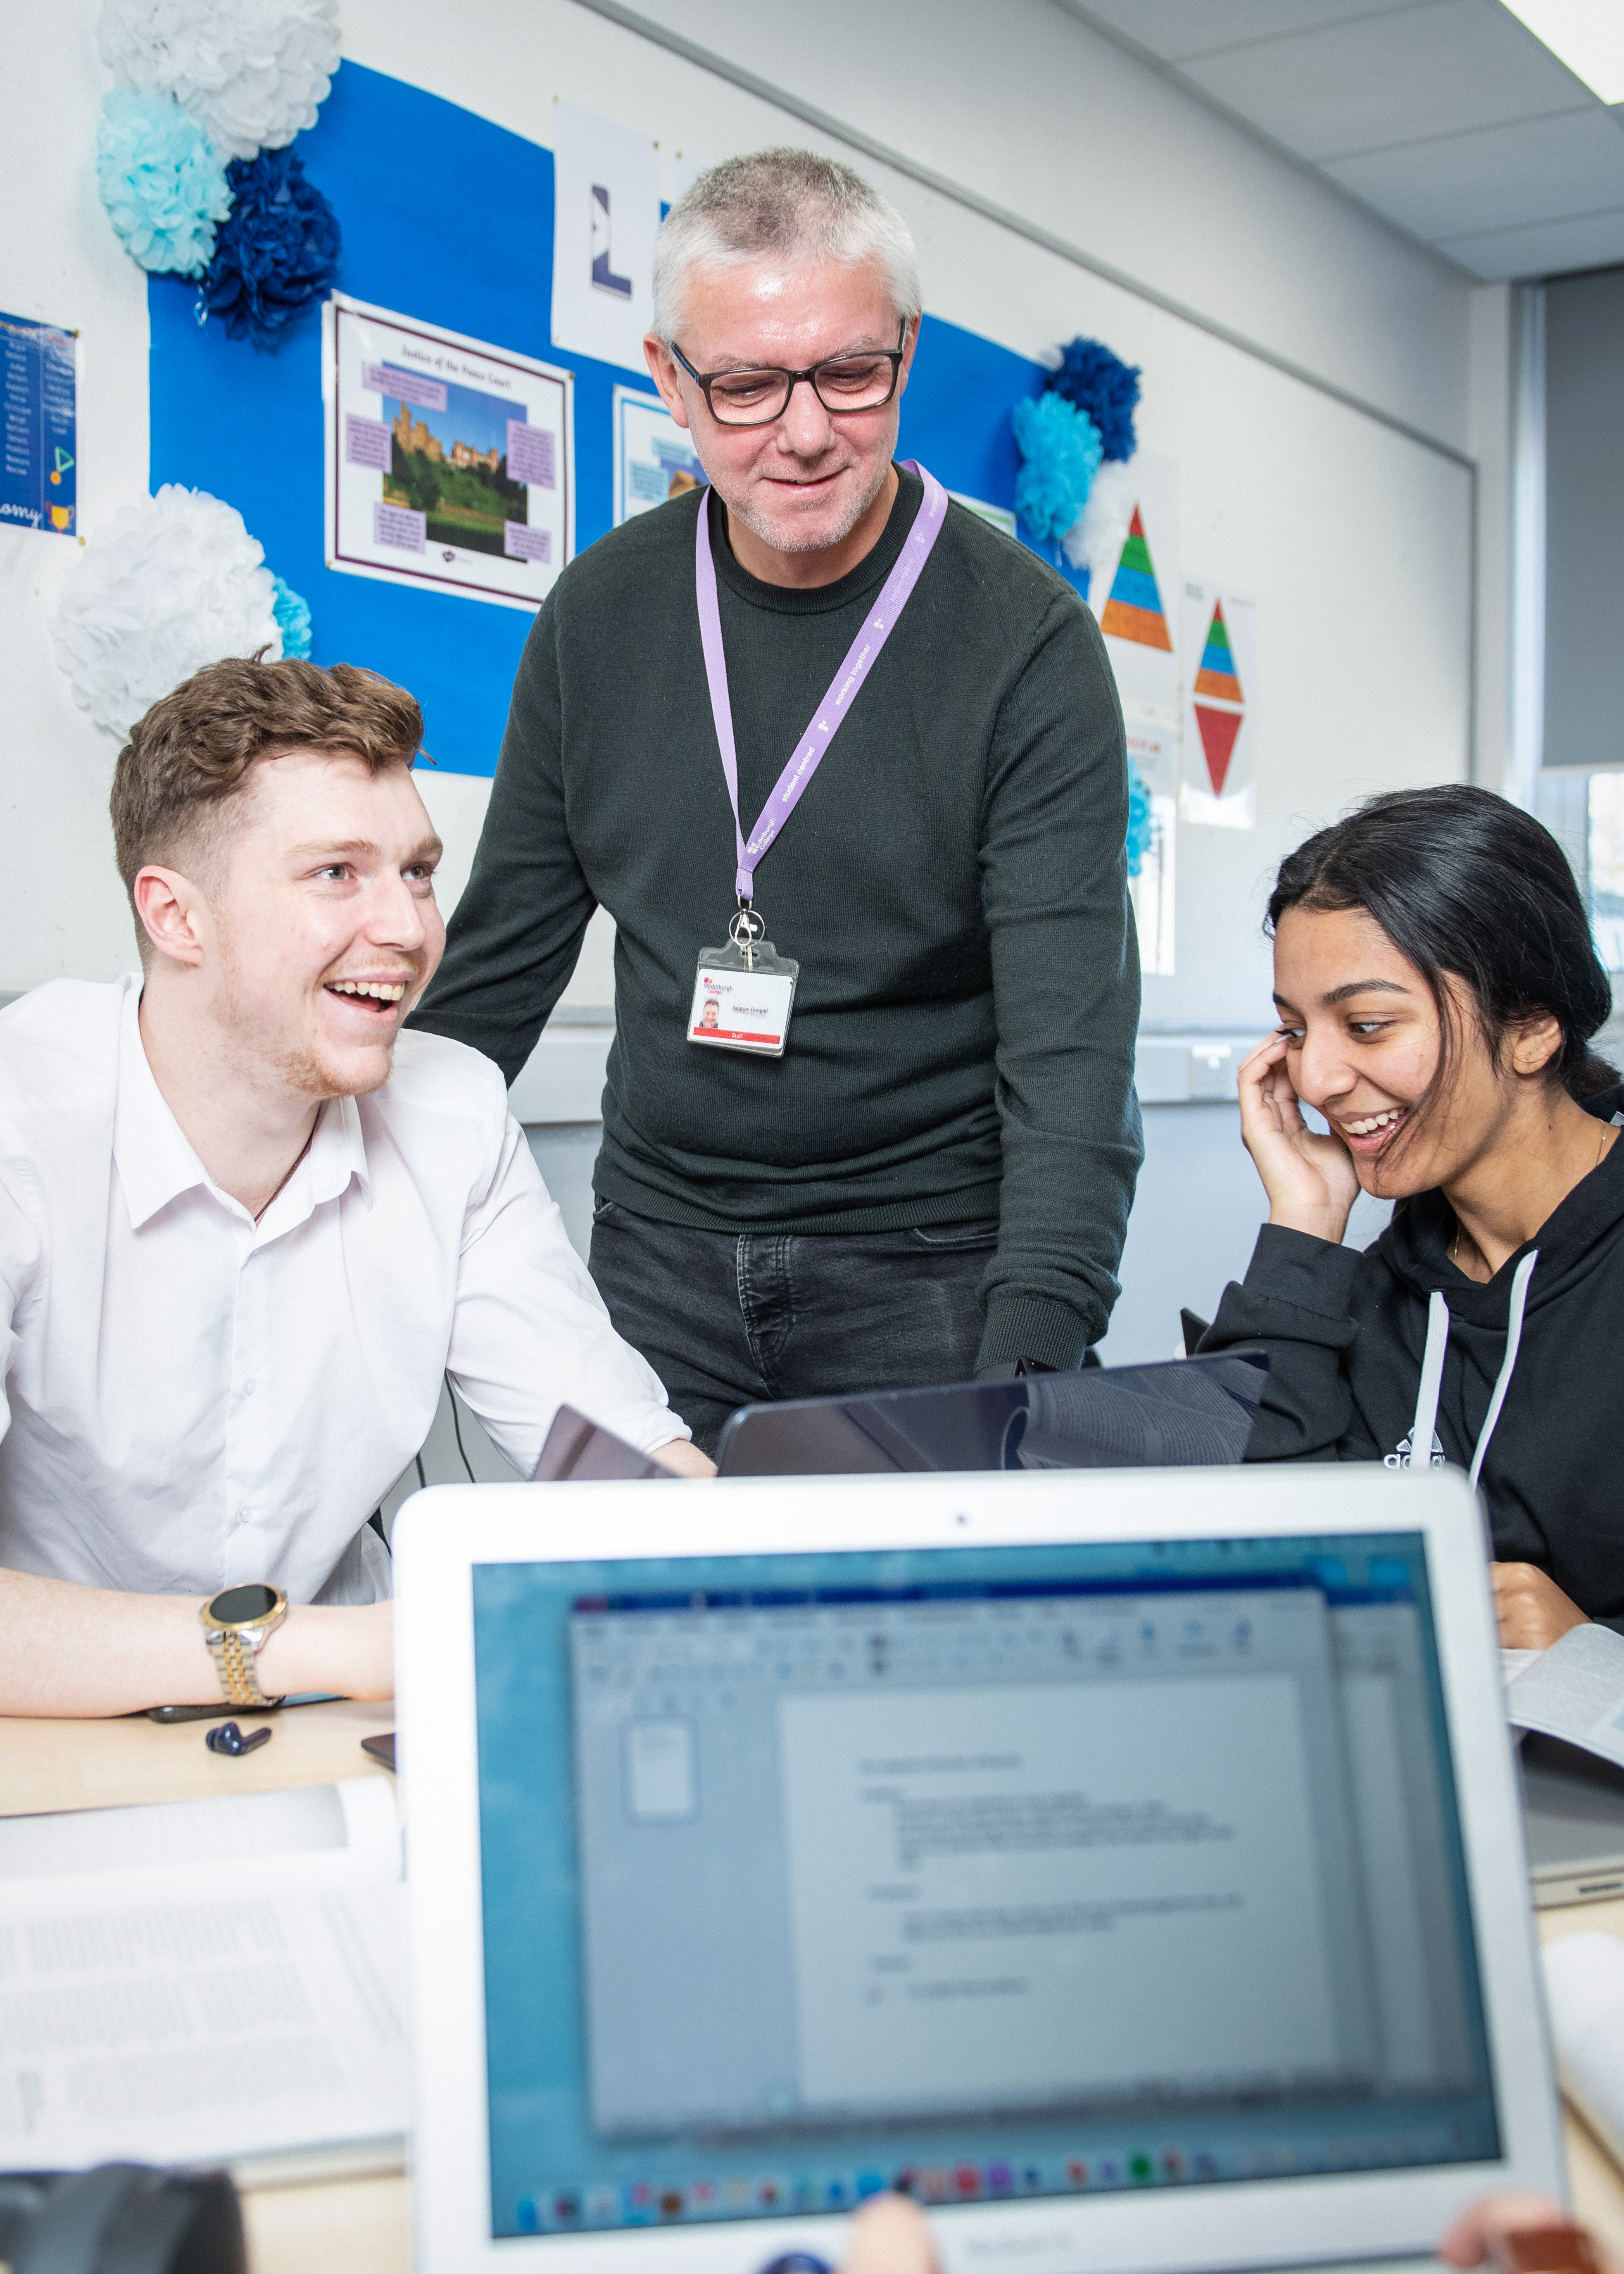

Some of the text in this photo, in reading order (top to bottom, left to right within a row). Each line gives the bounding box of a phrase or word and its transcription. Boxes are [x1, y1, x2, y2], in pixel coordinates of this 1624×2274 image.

[592, 183, 632, 301] L
[435, 355, 444, 370] of
[835, 644, 870, 705] working together
[782, 746, 815, 802] student centred
[754, 818, 776, 849] Edinburgh
[759, 830, 775, 850] College
[708, 983, 733, 992] Edinburgh
